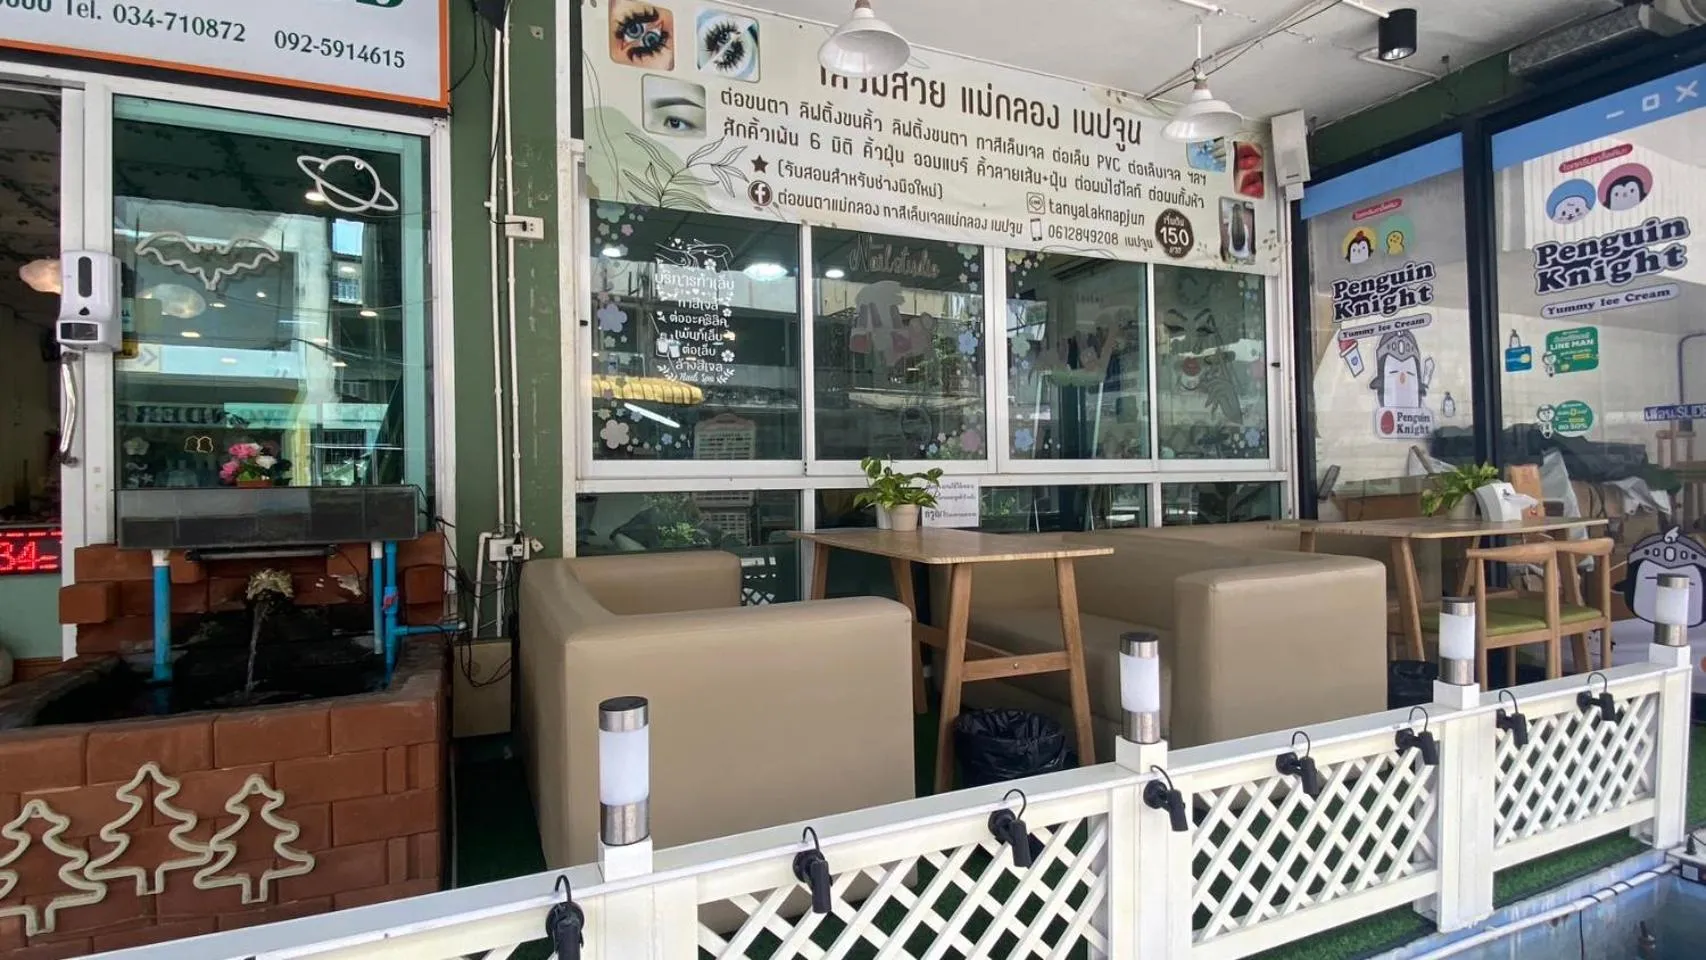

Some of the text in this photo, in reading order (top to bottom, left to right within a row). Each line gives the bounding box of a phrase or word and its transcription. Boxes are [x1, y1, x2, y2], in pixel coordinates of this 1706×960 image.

[67, 0, 101, 19] Tel.
[113, 4, 246, 42] 034-710872
[274, 30, 406, 68] 092-5914615
[961, 83, 1059, 129] แม่กลอง
[1073, 107, 1141, 152] เนปจูน
[721, 87, 1206, 186] ต่อขนตา ลิฟติ้งขนคิ้ว ลิฟติ้งขนตา ทาสีเล็บเจล ต่อเล็บ PVC ต่อเล็บเจล ฯลฯ
[810, 132, 820, 150] 6
[832, 136, 852, 156] มิติ
[863, 136, 904, 167] คิ้วฝุ่น
[914, 151, 968, 174] ออมแบร์
[778, 159, 943, 200] (รับสอนสำหรับช่างมือใหม่)
[778, 188, 1023, 237] ต่อขนตาแม่กลอง ทาสีเล็บเจลแม่กลอง เนปจูน
[1050, 201, 1145, 227] tanyalaknapjun
[1048, 225, 1119, 245] 0612849208
[1160, 226, 1189, 246] 150
[1535, 219, 1688, 267] Penguin
[1333, 262, 1434, 299] Penguin
[1537, 245, 1687, 292] Knight
[1334, 285, 1432, 321] Knight
[1548, 288, 1671, 316] Yummy Ice Cream
[1343, 326, 1376, 339] Yummy
[1394, 318, 1425, 330] Cream
[1550, 341, 1570, 351] LINE
[1396, 411, 1431, 424] Penguin
[1396, 422, 1430, 436] Knight
